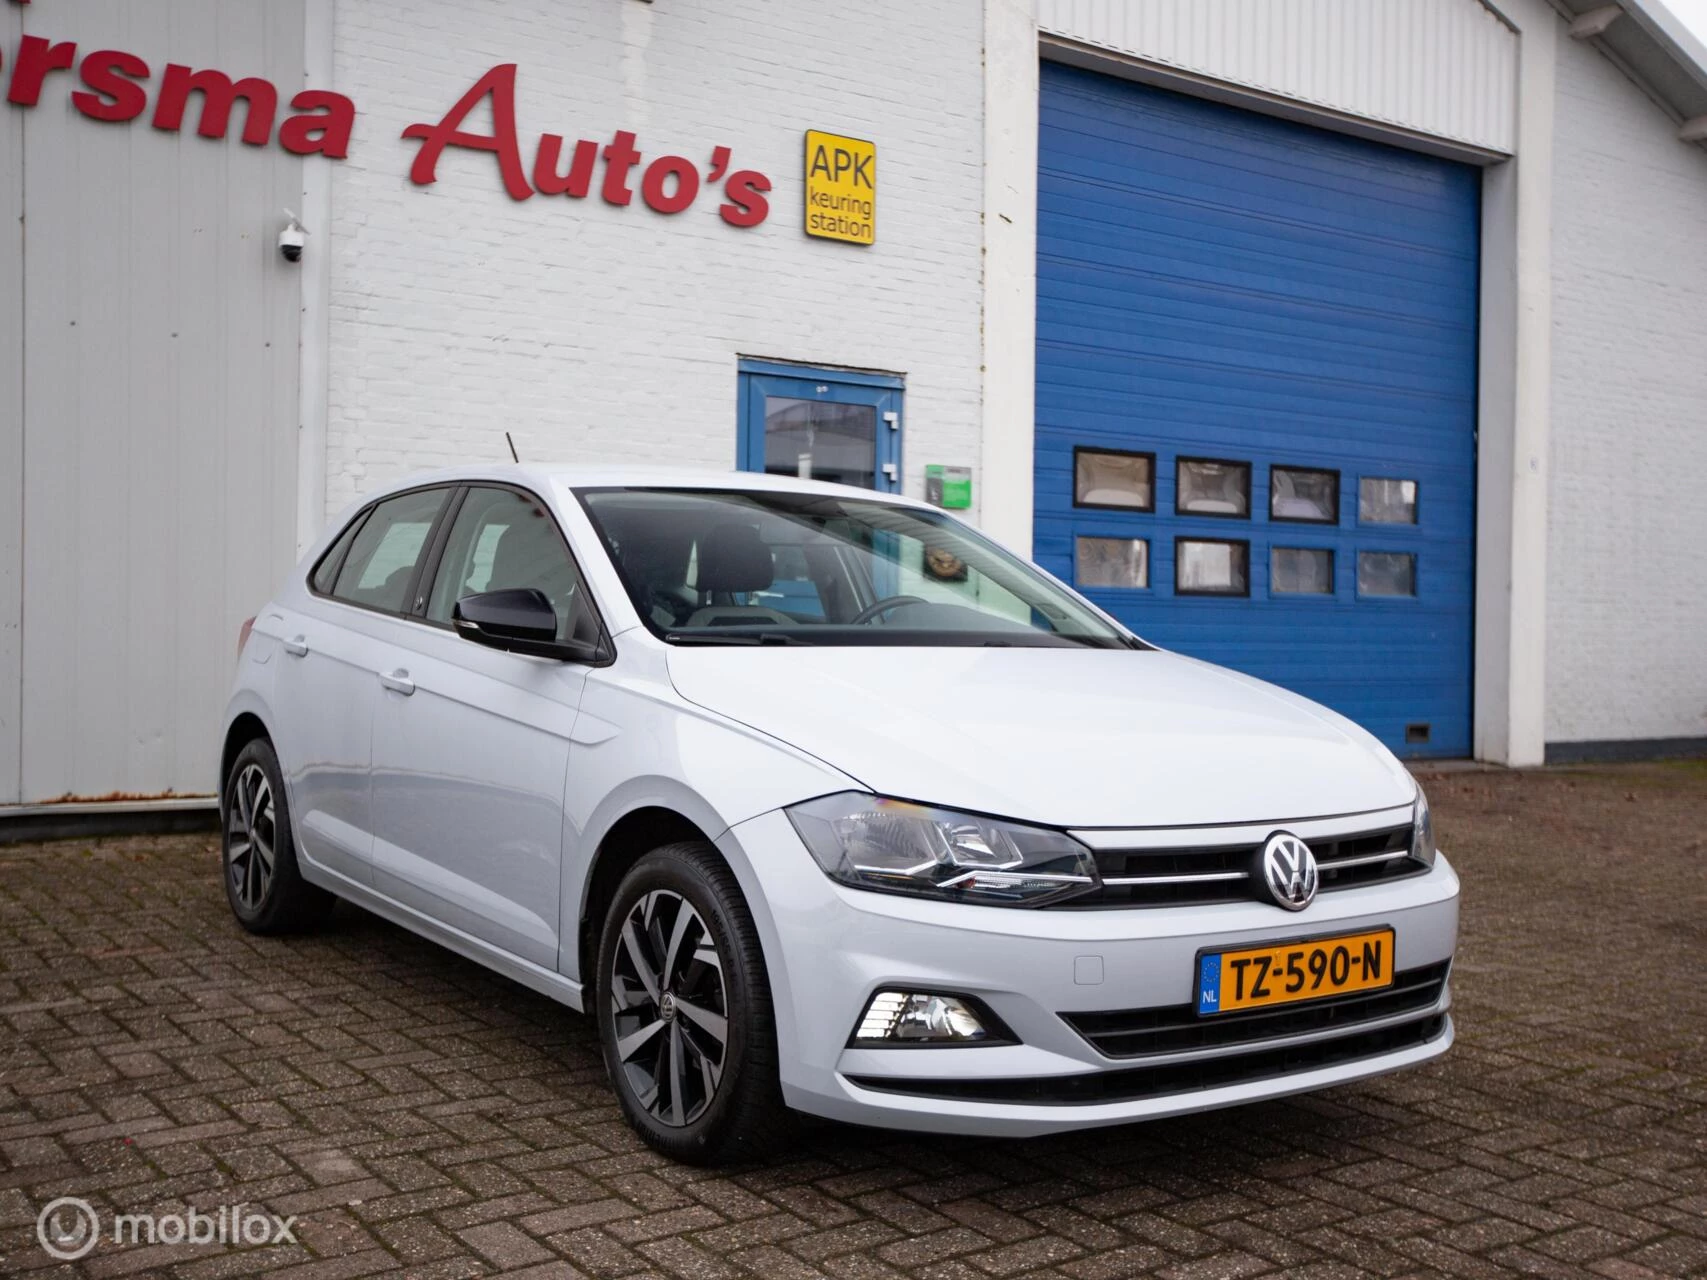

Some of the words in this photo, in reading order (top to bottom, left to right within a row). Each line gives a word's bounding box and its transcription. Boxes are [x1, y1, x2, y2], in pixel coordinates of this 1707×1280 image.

[0, 34, 357, 160] rsma
[401, 63, 773, 228] Auto's
[810, 145, 873, 190] APK
[810, 186, 872, 221] keuring
[810, 212, 872, 239] station
[1230, 940, 1382, 1001] TZ-590-N
[1202, 990, 1217, 1003] NL
